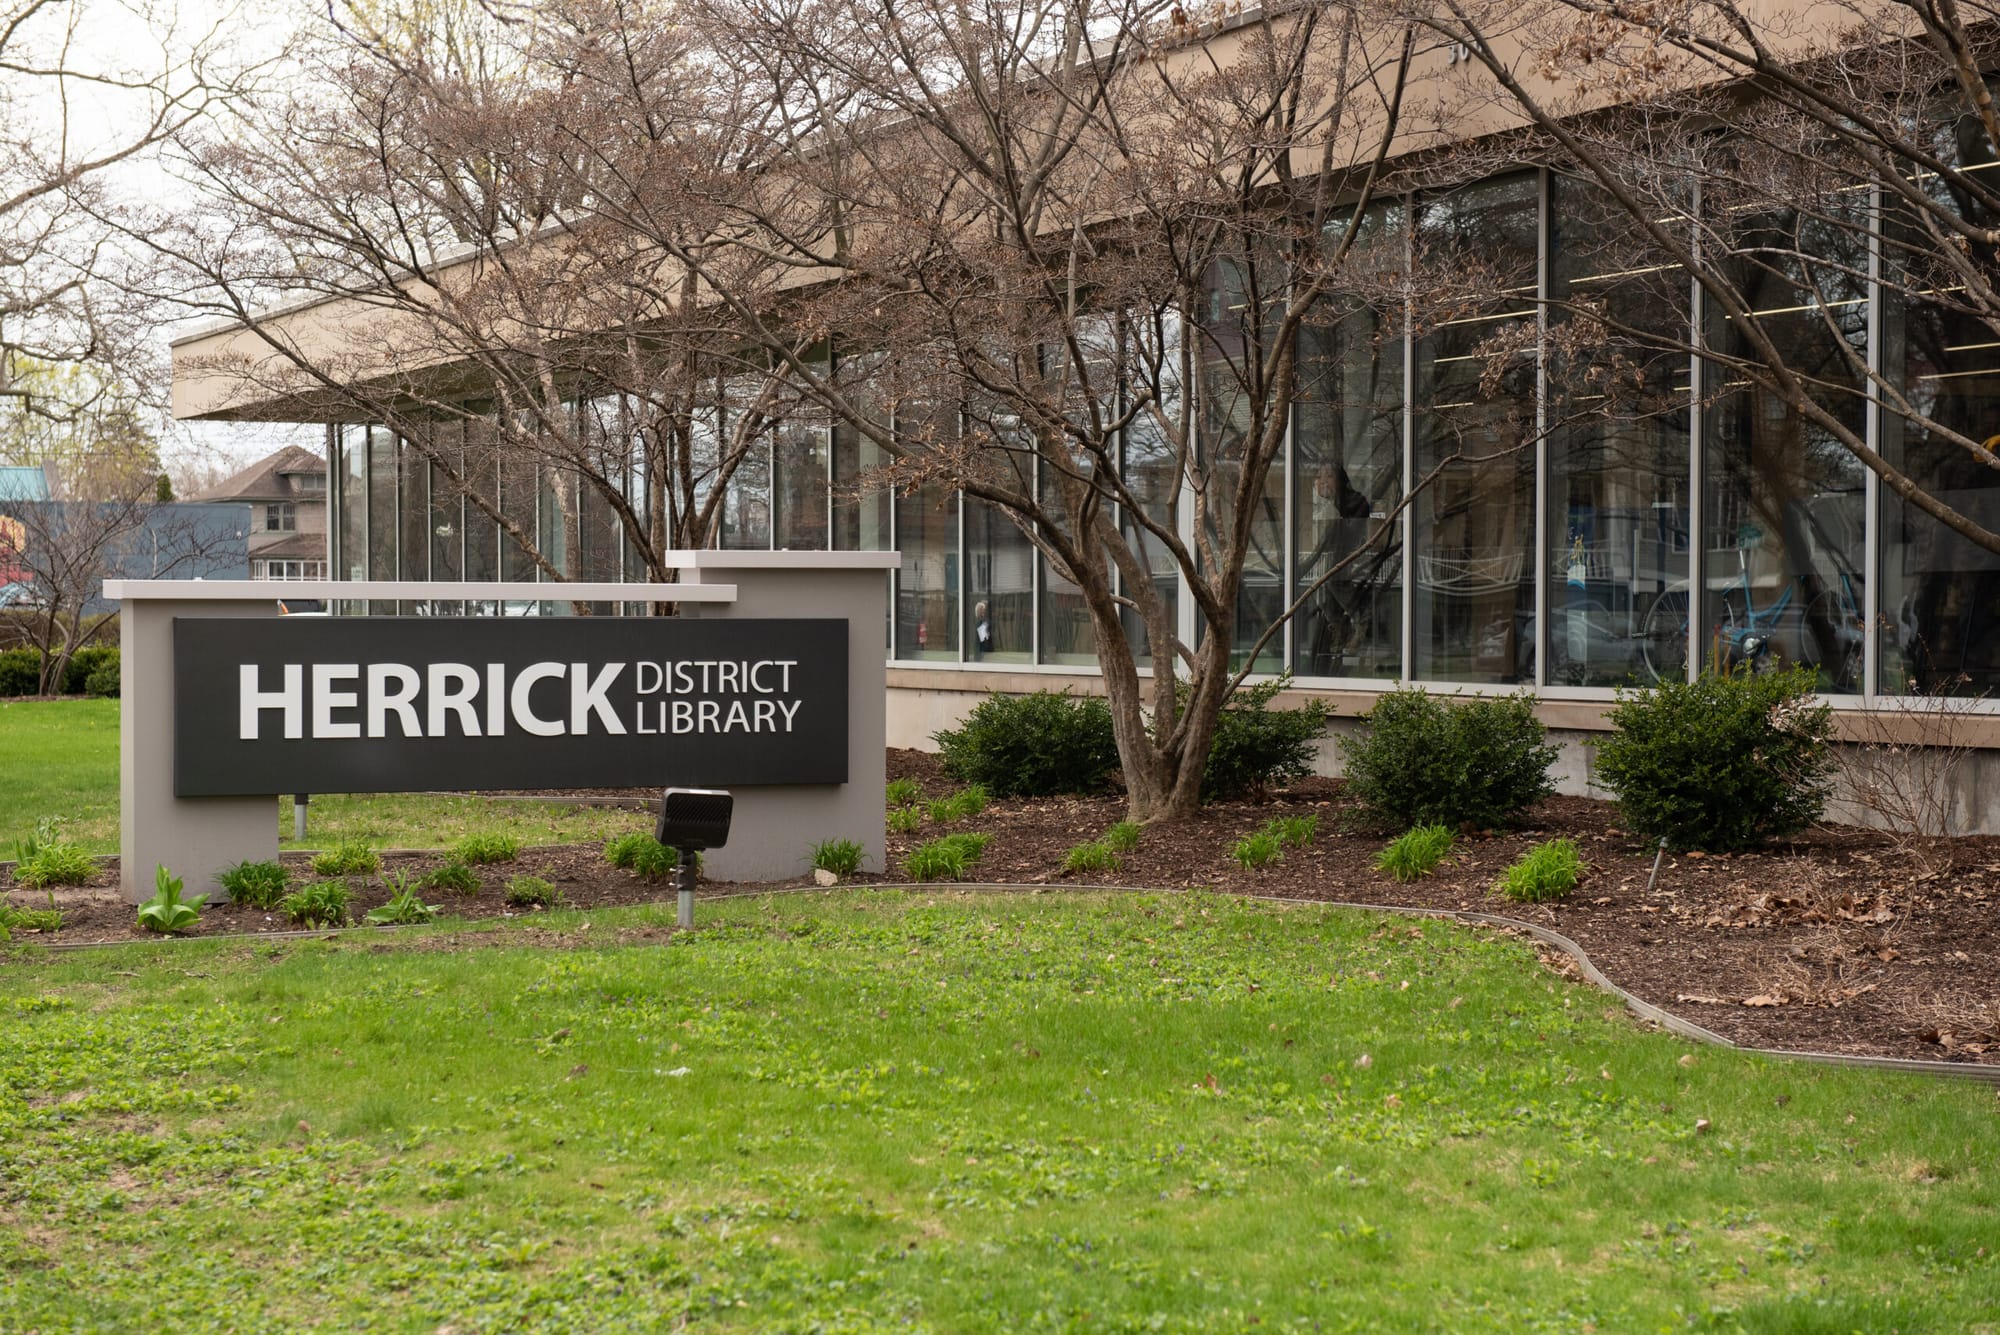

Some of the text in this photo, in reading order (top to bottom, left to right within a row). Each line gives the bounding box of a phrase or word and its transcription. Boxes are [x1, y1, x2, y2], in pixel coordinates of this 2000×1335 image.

[636, 661, 798, 694] DISTRICT
[239, 662, 627, 739] HERRICK
[637, 699, 802, 733] LIBRARY
